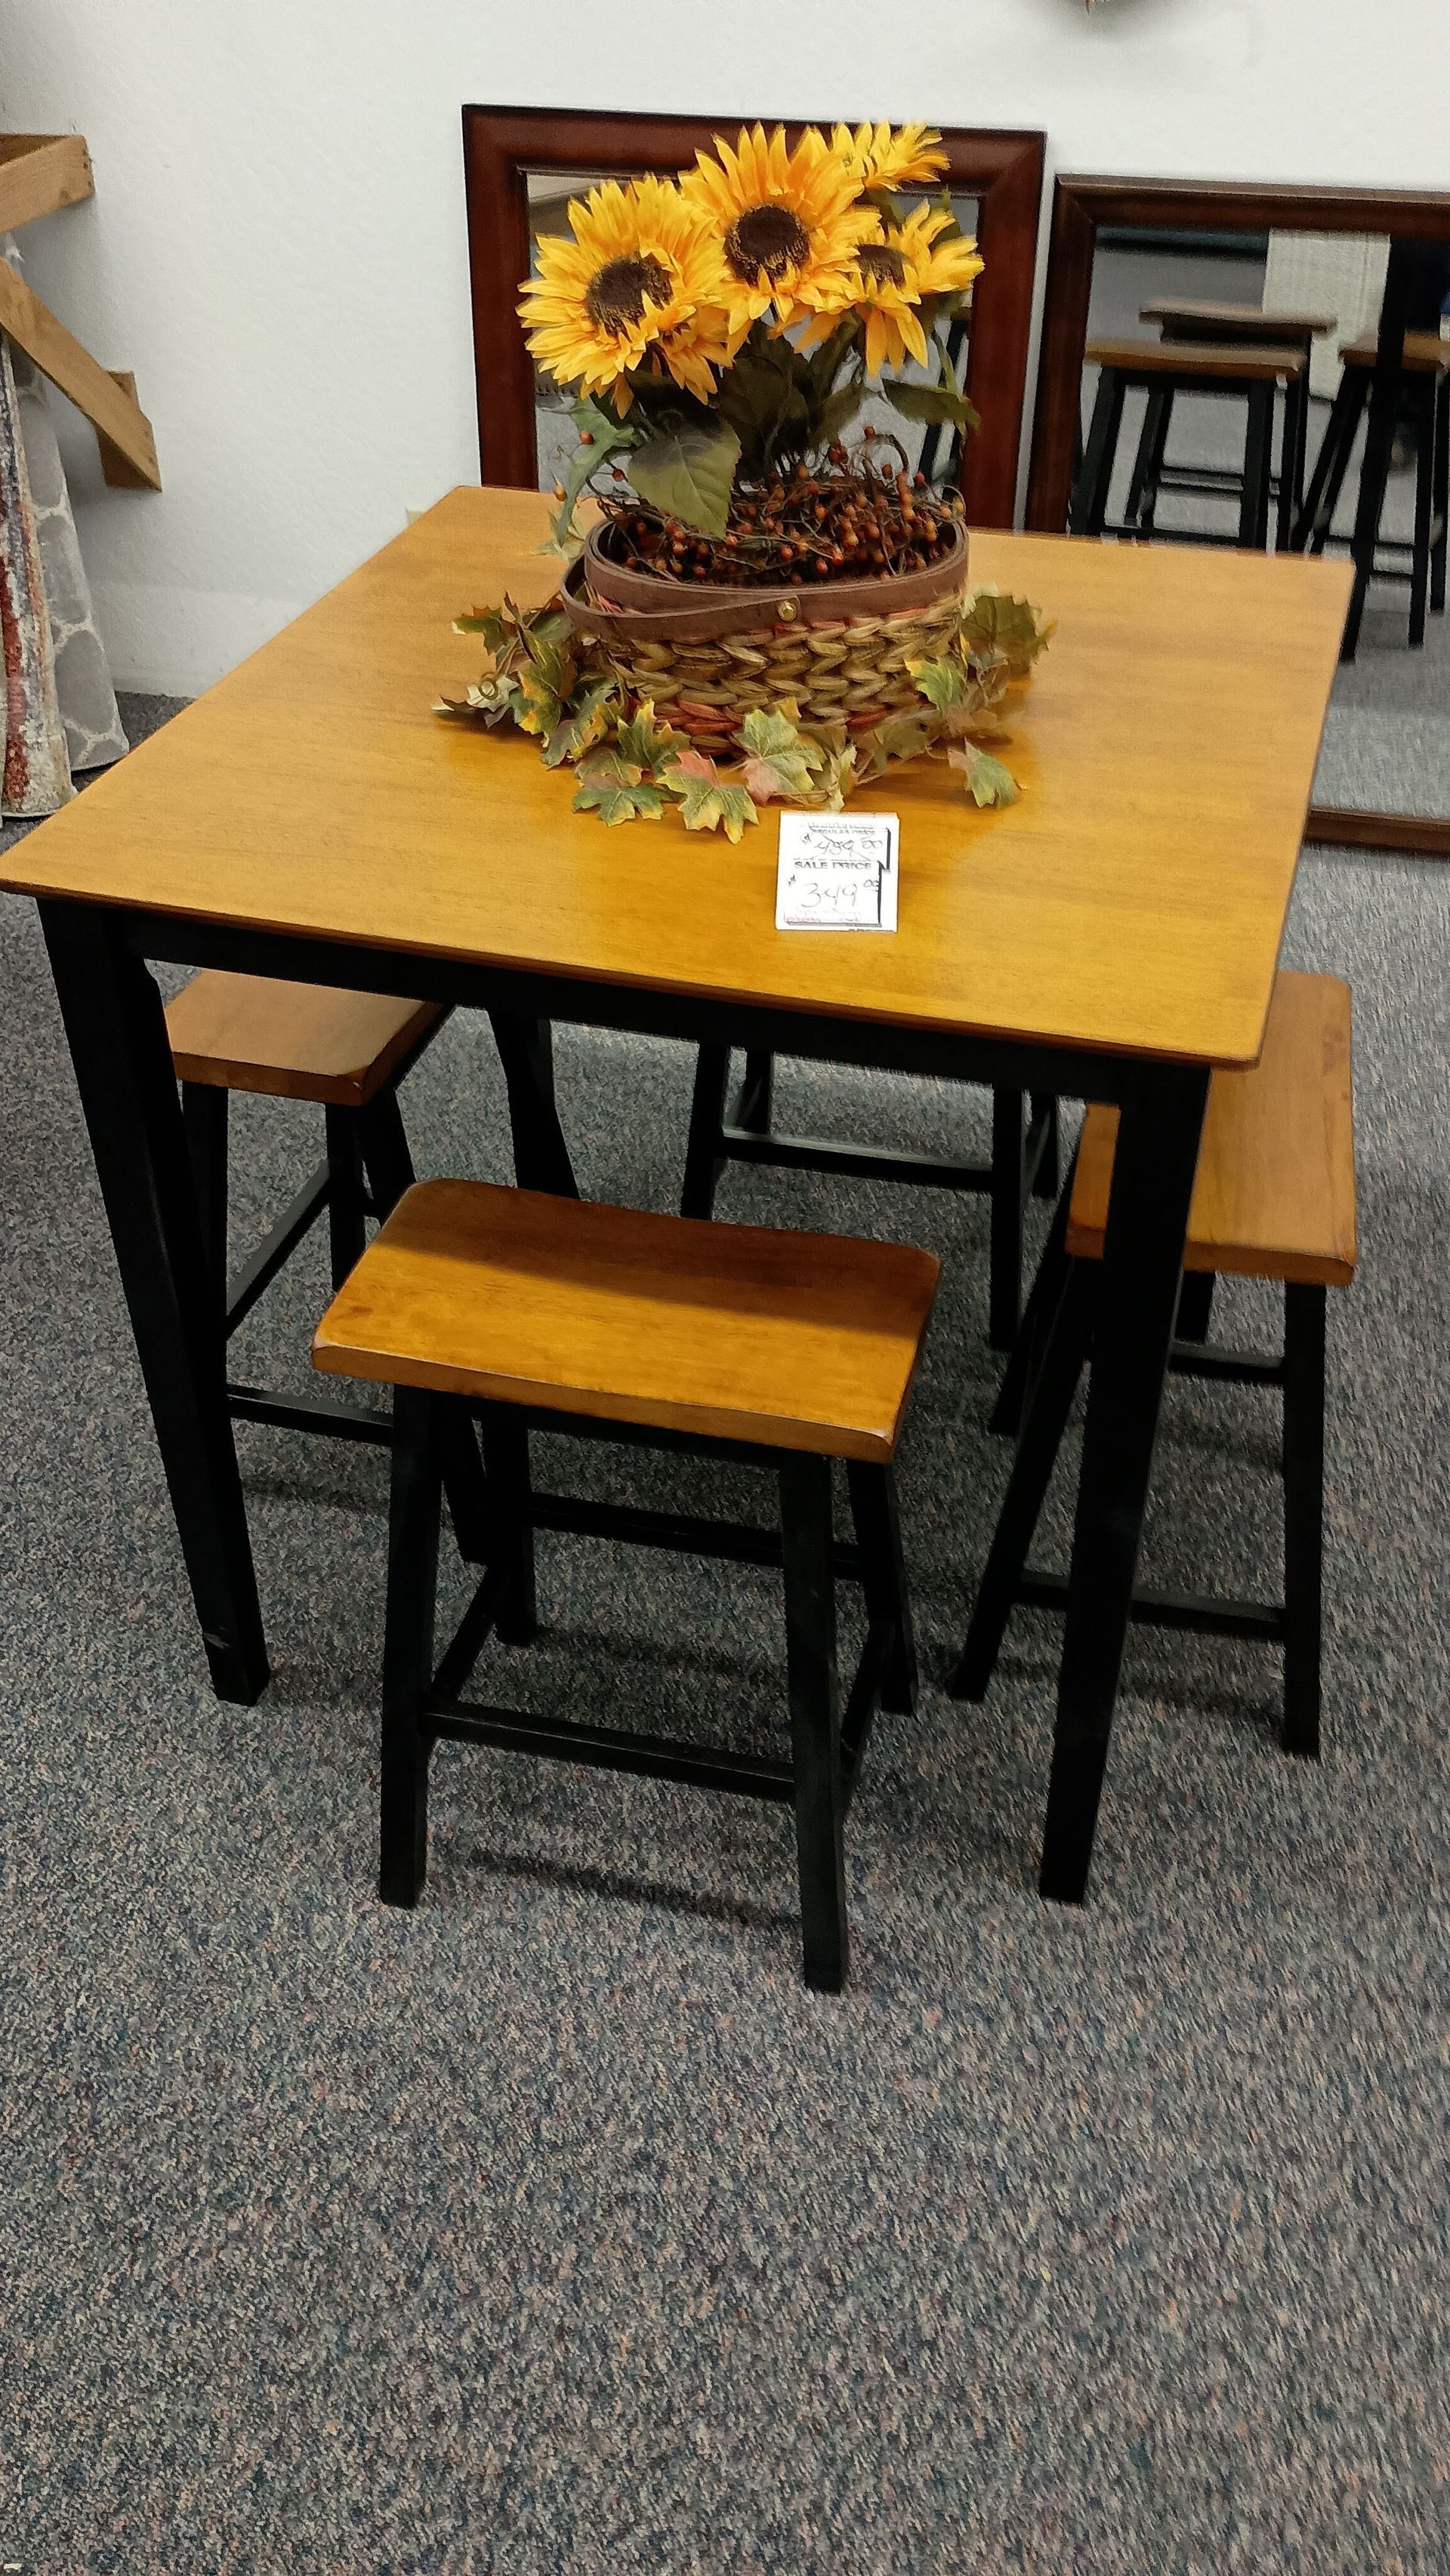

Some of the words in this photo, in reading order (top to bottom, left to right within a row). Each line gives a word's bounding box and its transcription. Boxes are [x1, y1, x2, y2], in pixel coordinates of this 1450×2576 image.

[794, 861, 828, 869] SALE
[832, 861, 872, 870] PRICE
[801, 882, 857, 907] 349
